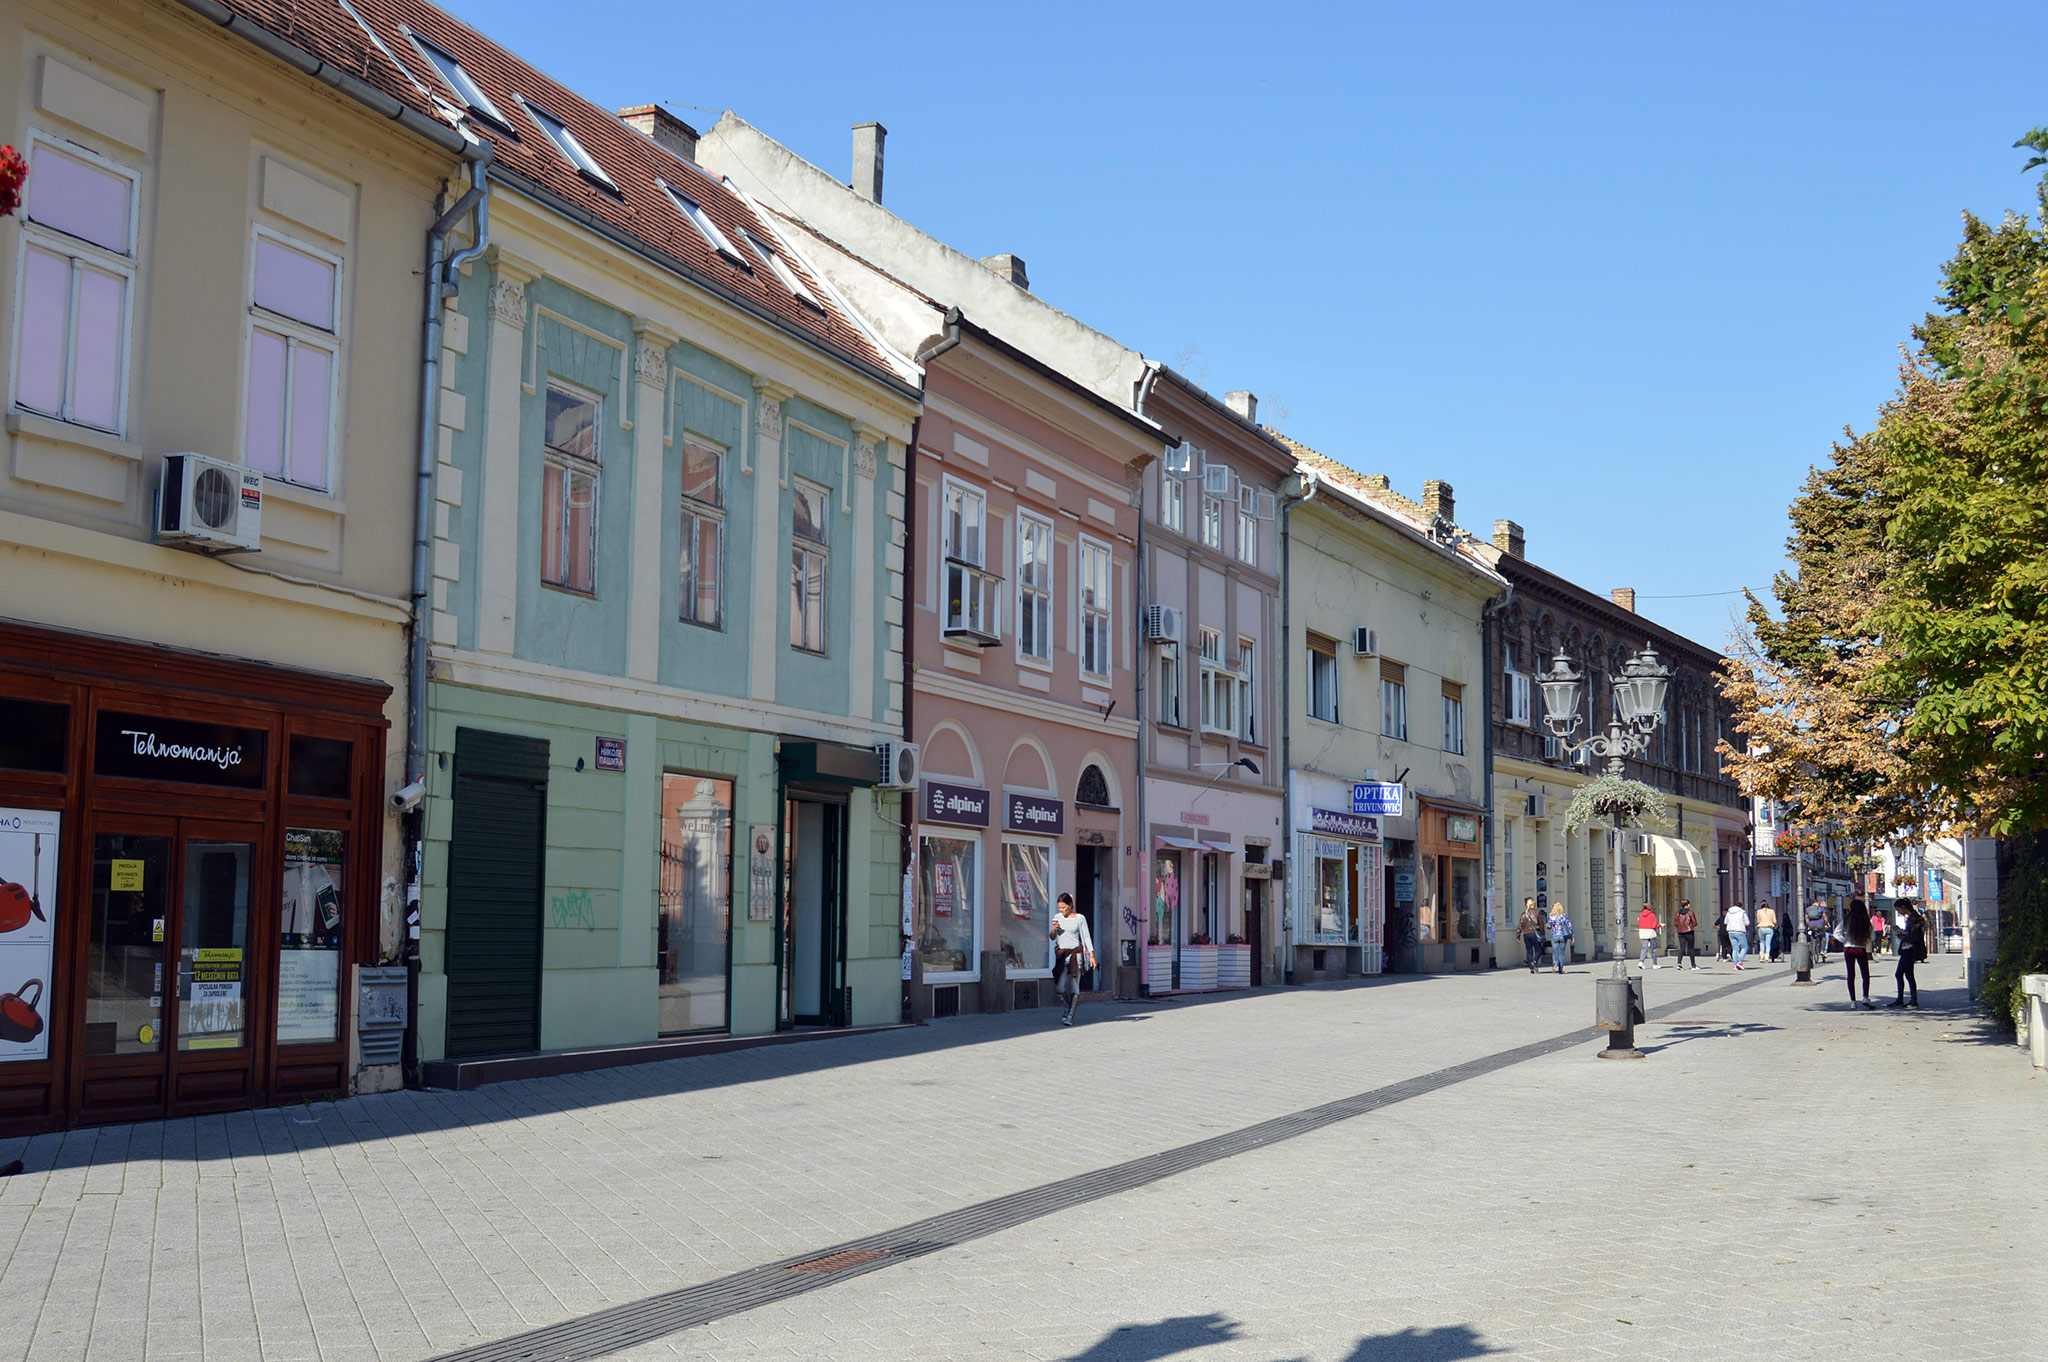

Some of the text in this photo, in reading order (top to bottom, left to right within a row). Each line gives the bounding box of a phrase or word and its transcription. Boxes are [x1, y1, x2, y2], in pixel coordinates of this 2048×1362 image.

[243, 475, 259, 487] WEG
[121, 730, 240, 769] Tehnomanija
[600, 748, 622, 758] НИКОЛЕ
[599, 757, 623, 767] ПАШИЋА
[1355, 786, 1400, 800] OPTIKA
[946, 795, 982, 814] alpina
[1354, 801, 1400, 812] TRIVUNOVIĆ
[1026, 806, 1057, 823] alpina
[1316, 812, 1373, 831] OČNA KUĆA
[286, 833, 311, 843] ChatSim
[194, 971, 201, 981] 12
[227, 971, 239, 981] RATA
